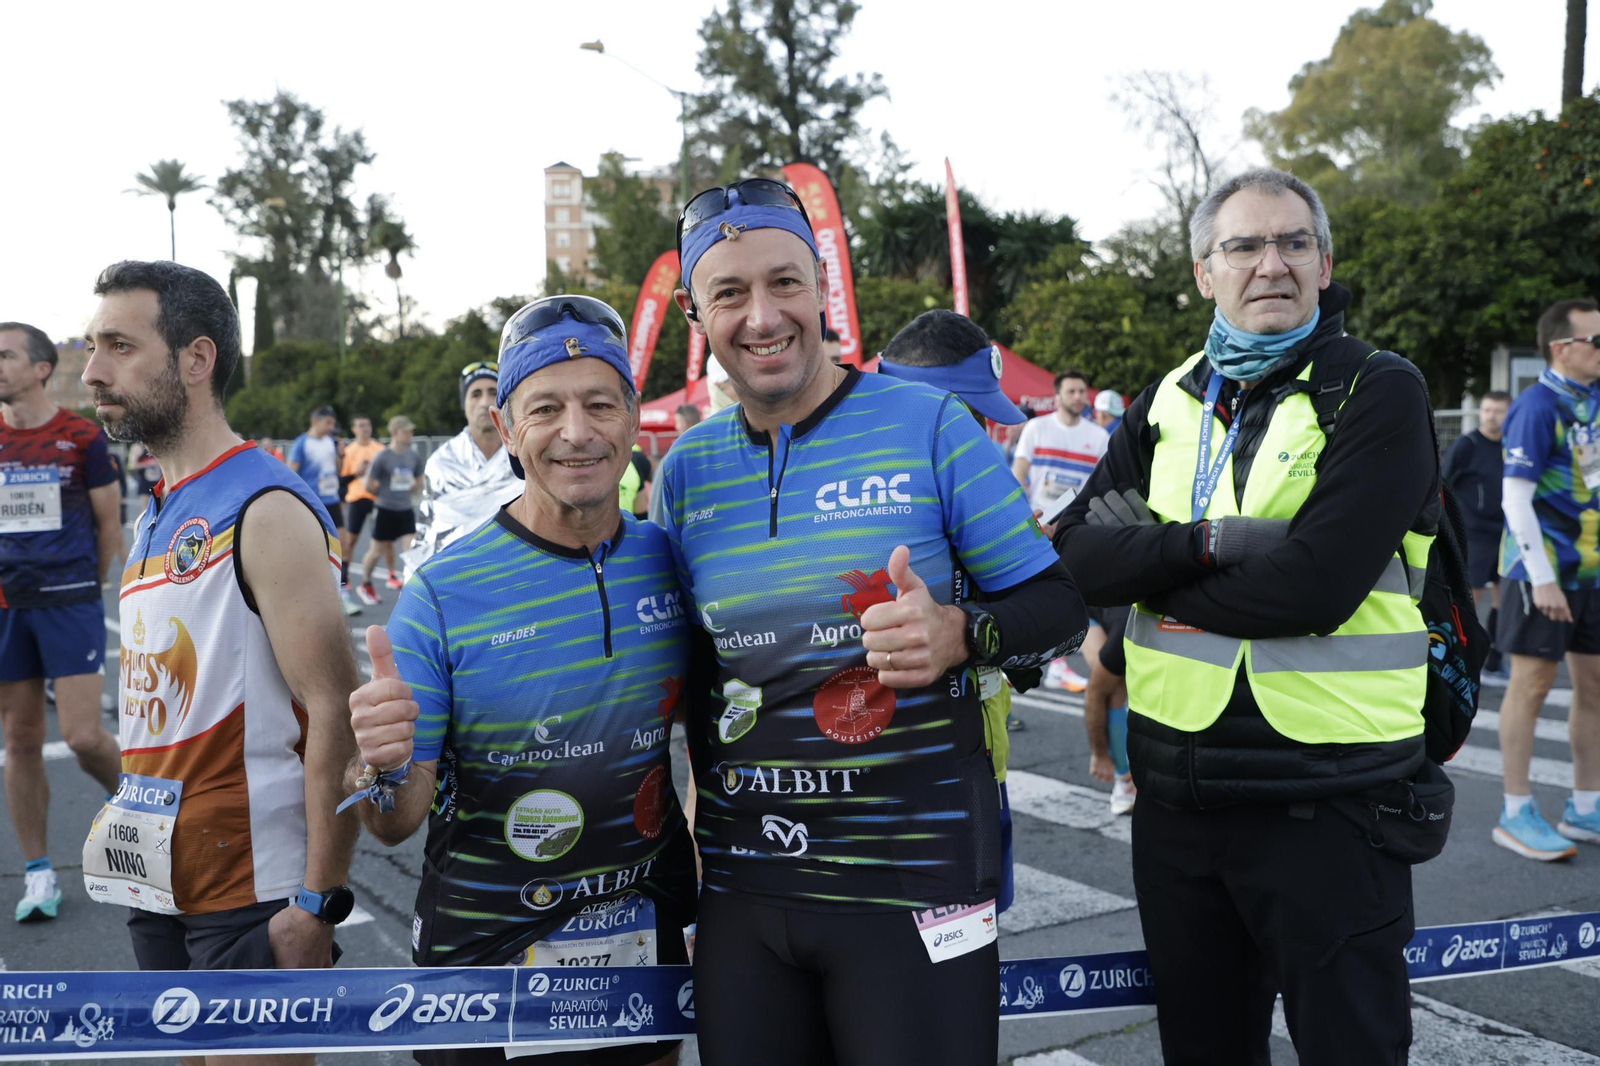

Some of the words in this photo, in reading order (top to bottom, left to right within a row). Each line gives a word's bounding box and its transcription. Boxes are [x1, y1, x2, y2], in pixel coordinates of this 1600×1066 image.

[1202, 413, 1210, 442] ZURICH
[1199, 444, 1207, 474] Maratón
[1205, 467, 1220, 495] ZURICH
[1217, 436, 1235, 465] Maratón
[10, 472, 50, 483] ZURICH
[1, 502, 45, 516] RUBÉN
[813, 505, 912, 523] ENTRONCAMENTO
[169, 518, 198, 550] DEPORTIVO
[810, 622, 862, 648] Agro
[630, 727, 665, 751] Agro
[825, 727, 882, 743] POUSEIRO
[487, 740, 604, 767] Campoclean
[748, 766, 860, 794] ALBIT
[1379, 805, 1402, 815] Sport
[108, 822, 140, 844] 11608
[105, 847, 147, 879] NINO
[570, 855, 657, 900] ALBIT
[561, 906, 636, 932] ZURICH
[1520, 924, 1548, 936] ZURICH
[943, 929, 963, 942] asics
[1460, 938, 1500, 961] asics
[1519, 949, 1546, 961] SEVILLA
[2, 984, 53, 999] RICH
[552, 977, 610, 992] ZURICH
[204, 997, 334, 1025] ZURICH
[412, 993, 500, 1023] asics
[551, 997, 608, 1013] MARATÓN
[549, 1015, 608, 1030] SEVILLA
